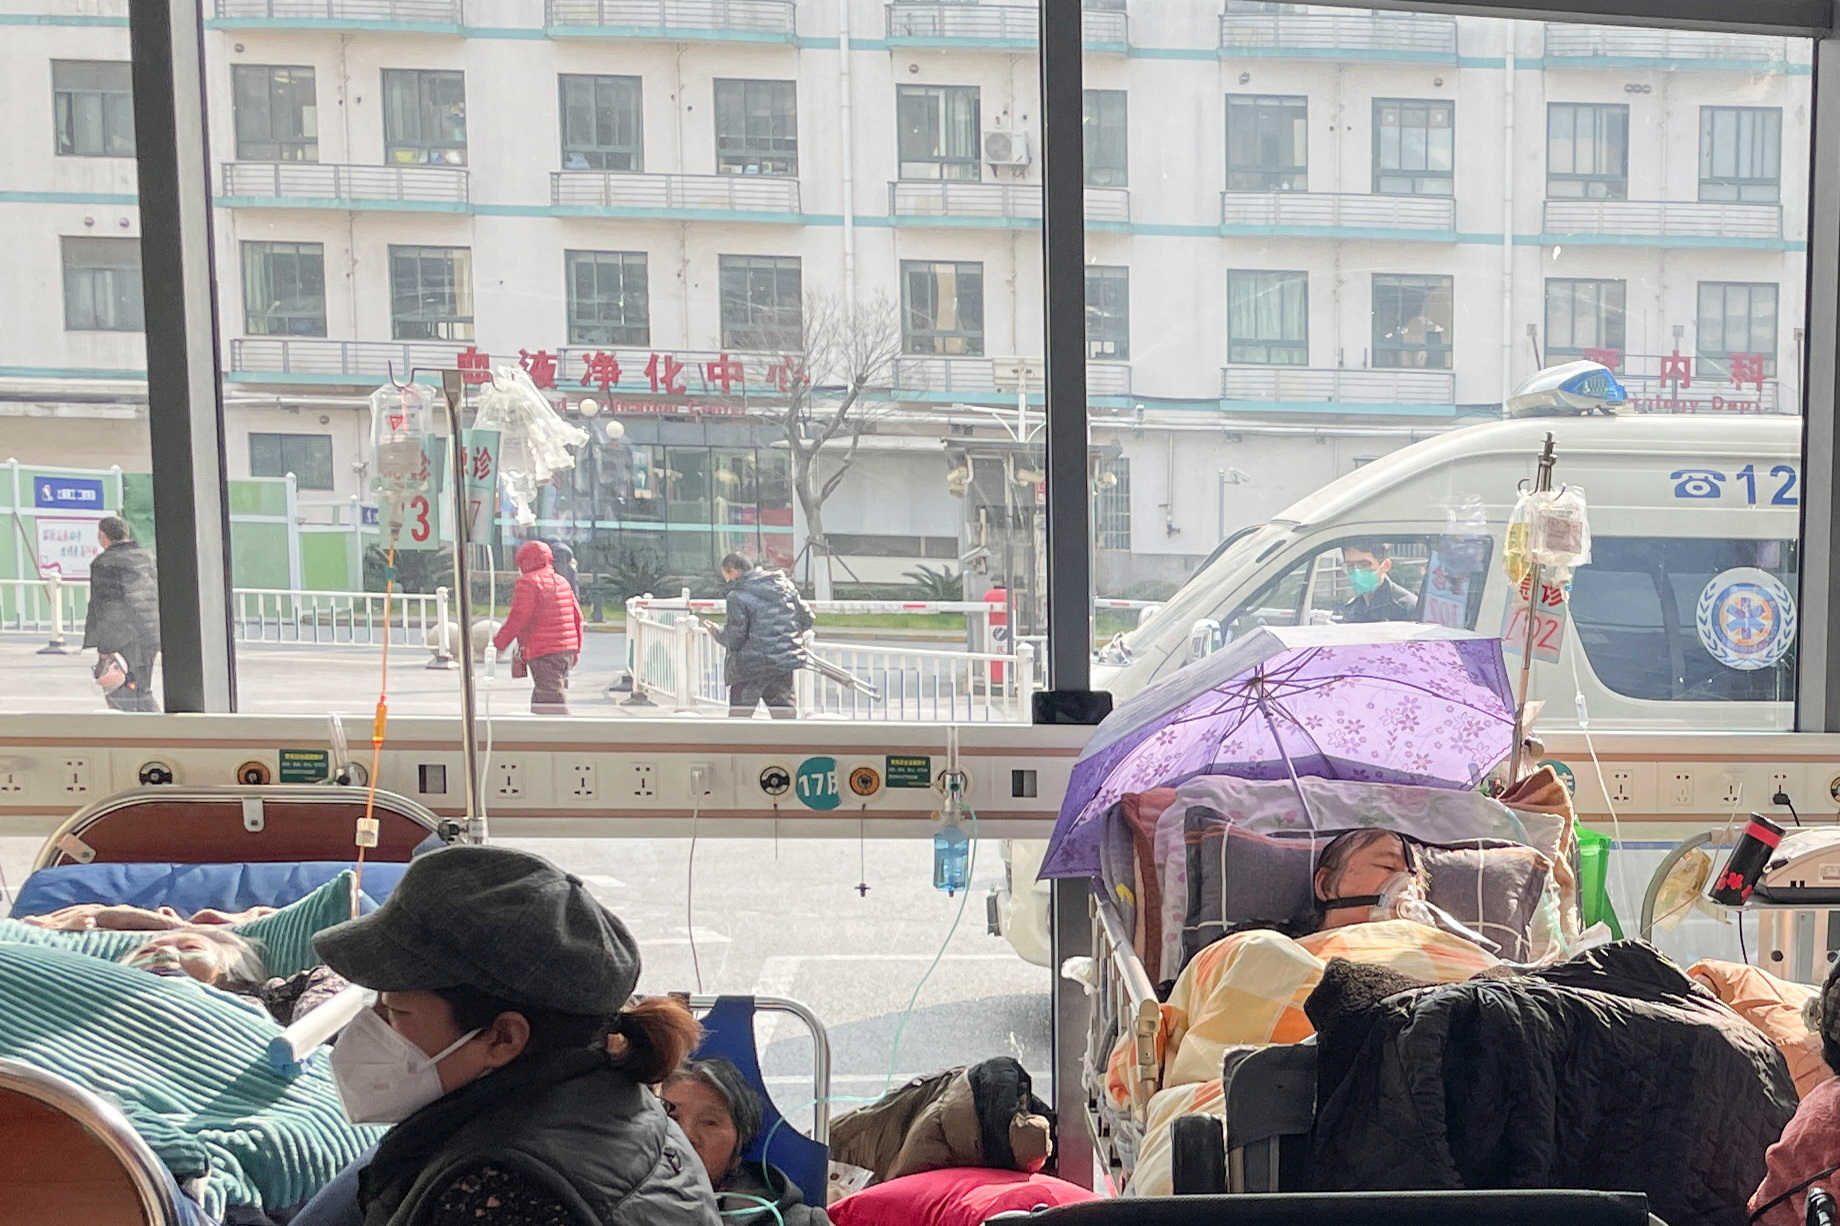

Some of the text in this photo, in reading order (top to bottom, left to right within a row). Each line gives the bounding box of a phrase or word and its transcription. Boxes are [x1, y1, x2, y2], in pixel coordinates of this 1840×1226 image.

[457, 347, 810, 394] 血液净化中心
